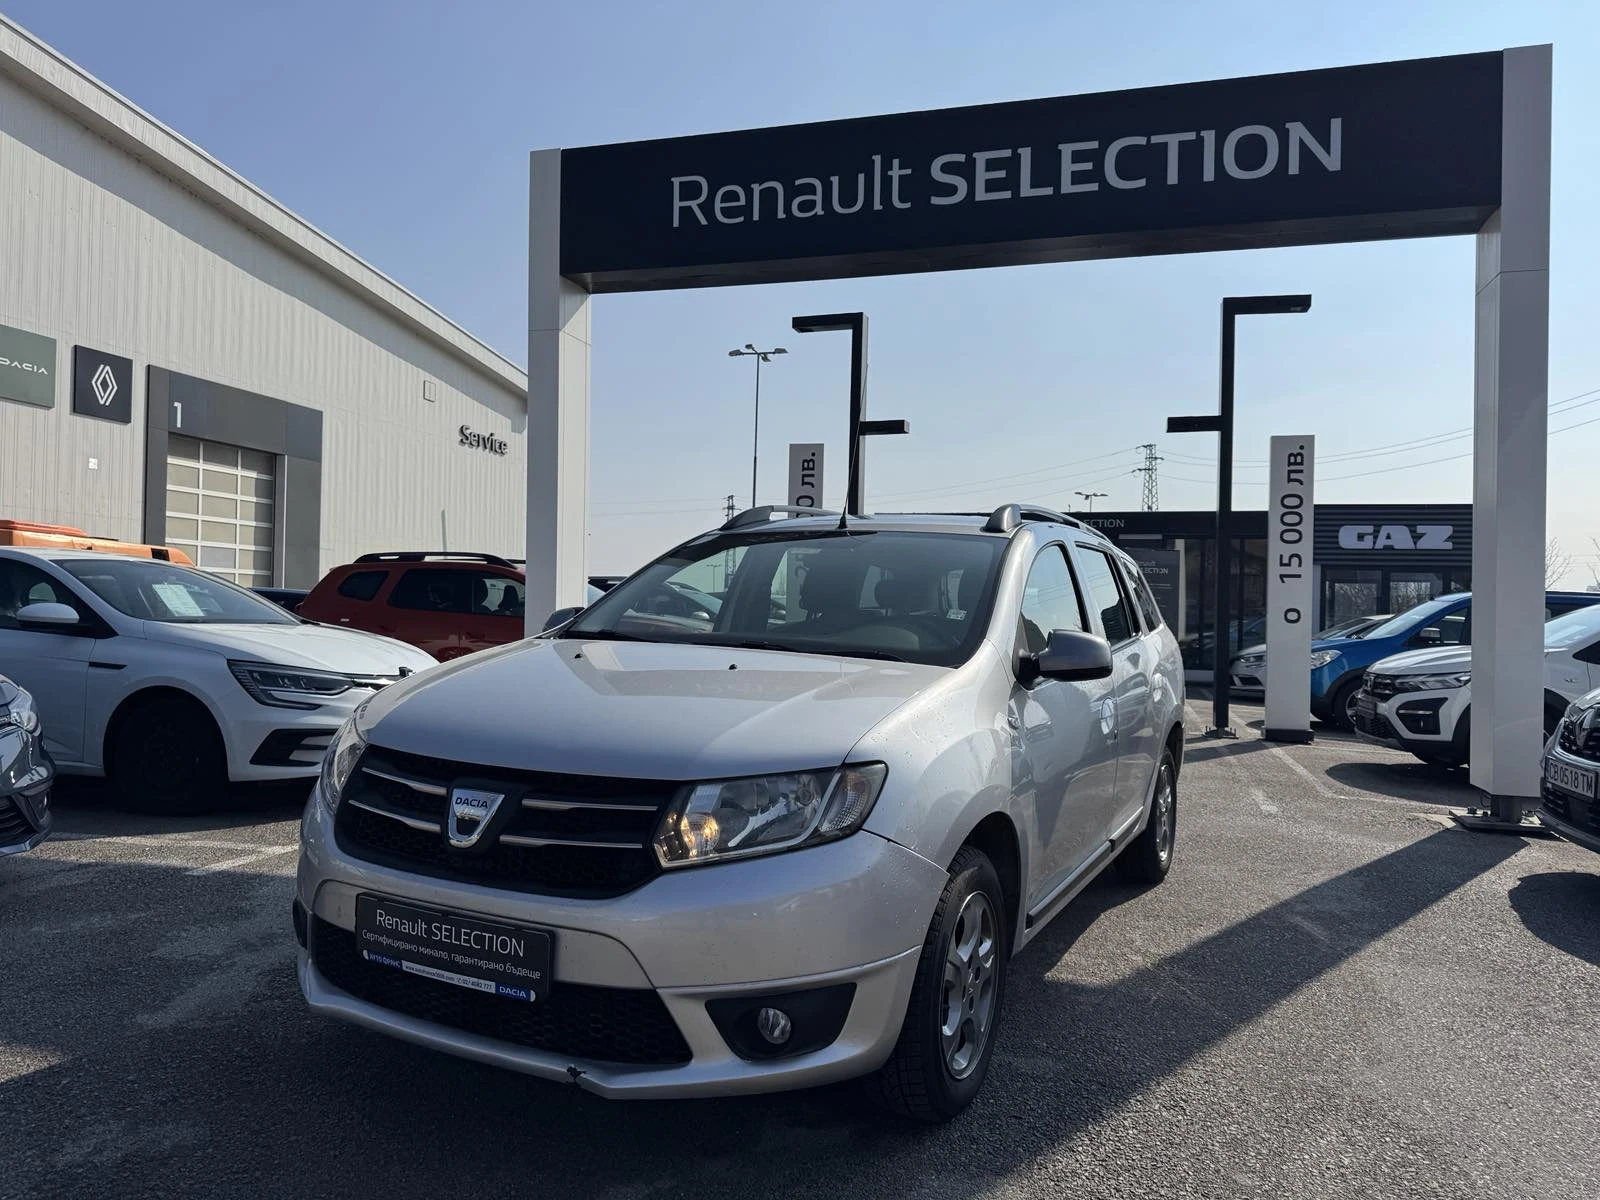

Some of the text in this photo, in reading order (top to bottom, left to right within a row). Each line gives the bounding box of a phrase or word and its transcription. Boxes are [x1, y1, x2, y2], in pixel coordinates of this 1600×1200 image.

[671, 117, 1342, 228] Renault SELECTION
[173, 401, 182, 428] 1
[459, 424, 508, 457] Service
[1280, 493, 1304, 544] 000
[1338, 525, 1453, 549] GAZ
[1279, 553, 1303, 584] 15
[1560, 766, 1579, 789] 0518
[455, 796, 488, 809] DACIA
[376, 909, 524, 957] Renault SELECTION
[362, 929, 541, 979] Сертифицирано минало, гарантирано бъдеще
[499, 986, 526, 998] DACIA
